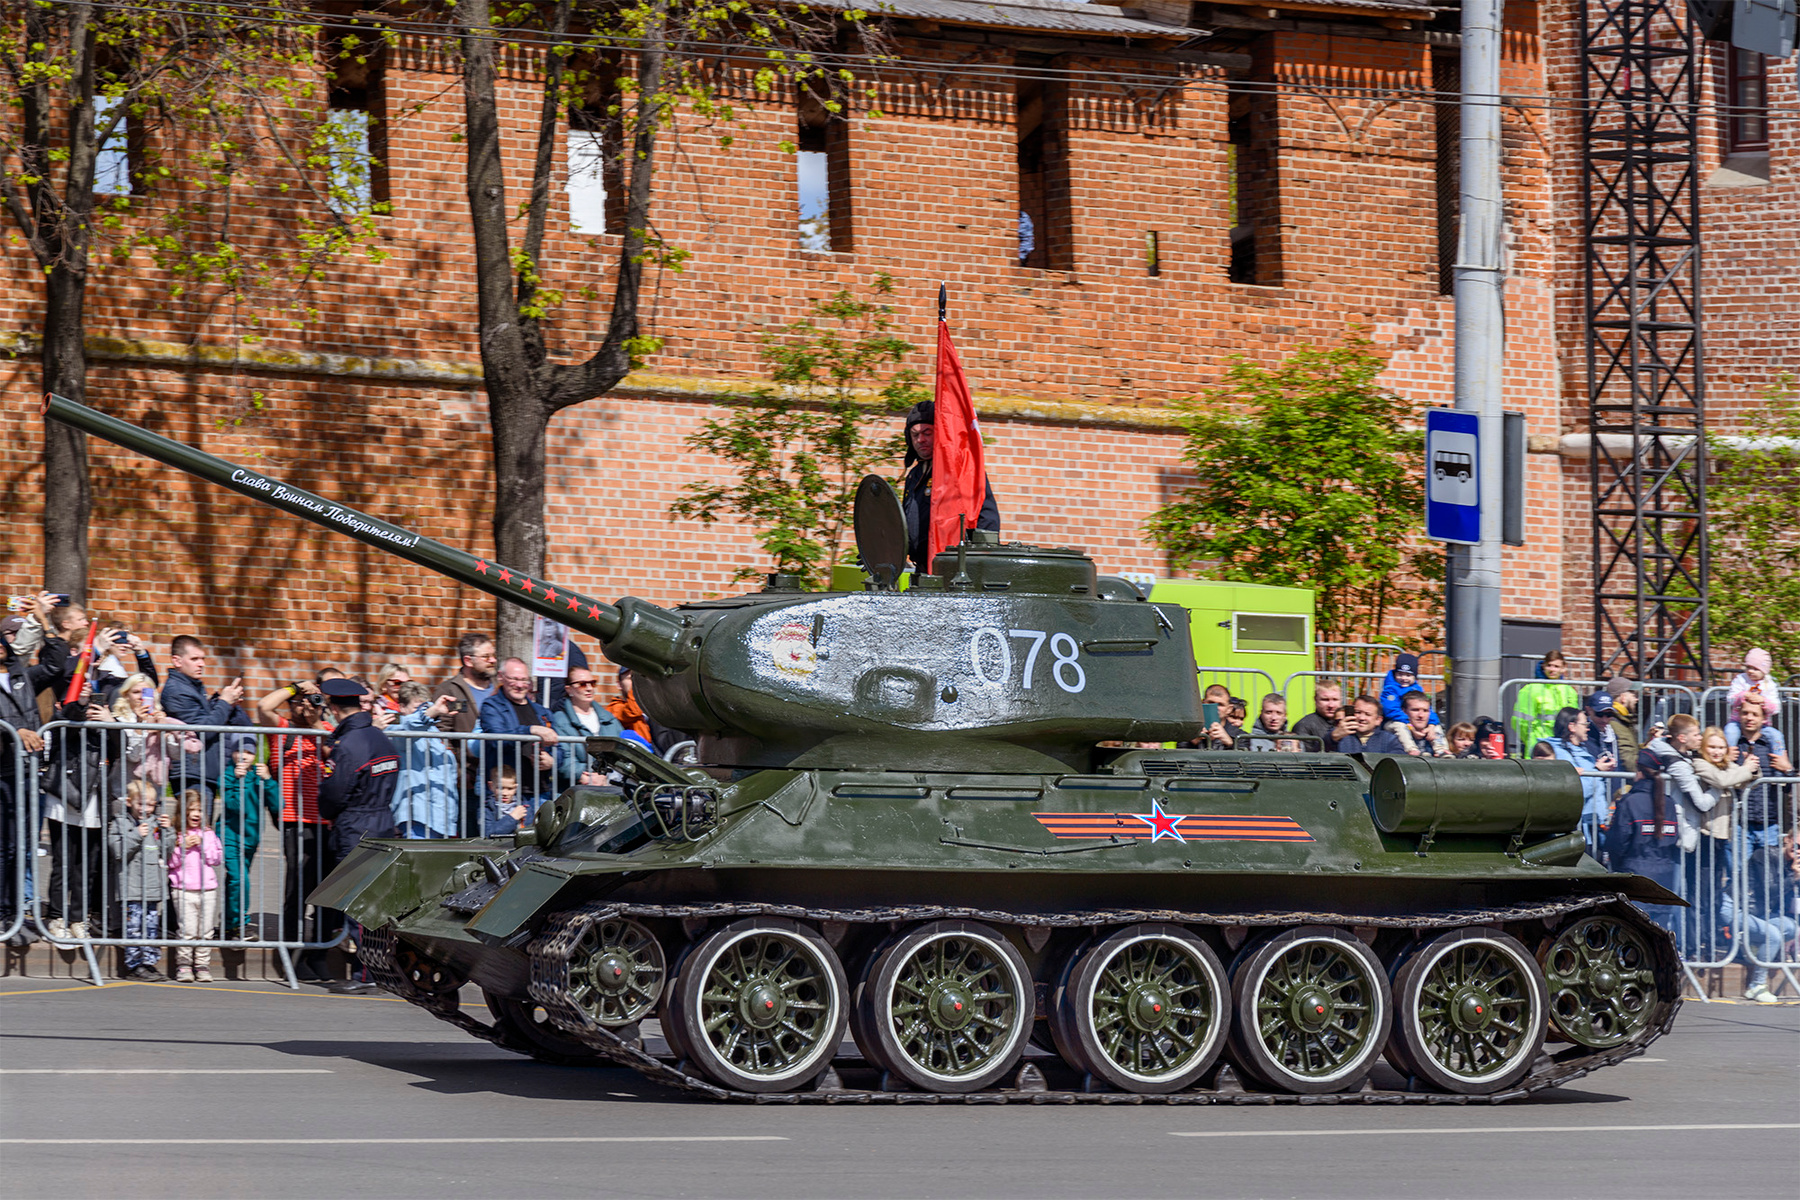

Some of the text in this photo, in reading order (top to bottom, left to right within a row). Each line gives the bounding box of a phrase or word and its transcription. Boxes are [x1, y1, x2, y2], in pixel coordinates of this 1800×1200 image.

[231, 469, 420, 548] Слава Воинам Победителям!
[971, 626, 1086, 693] 078
